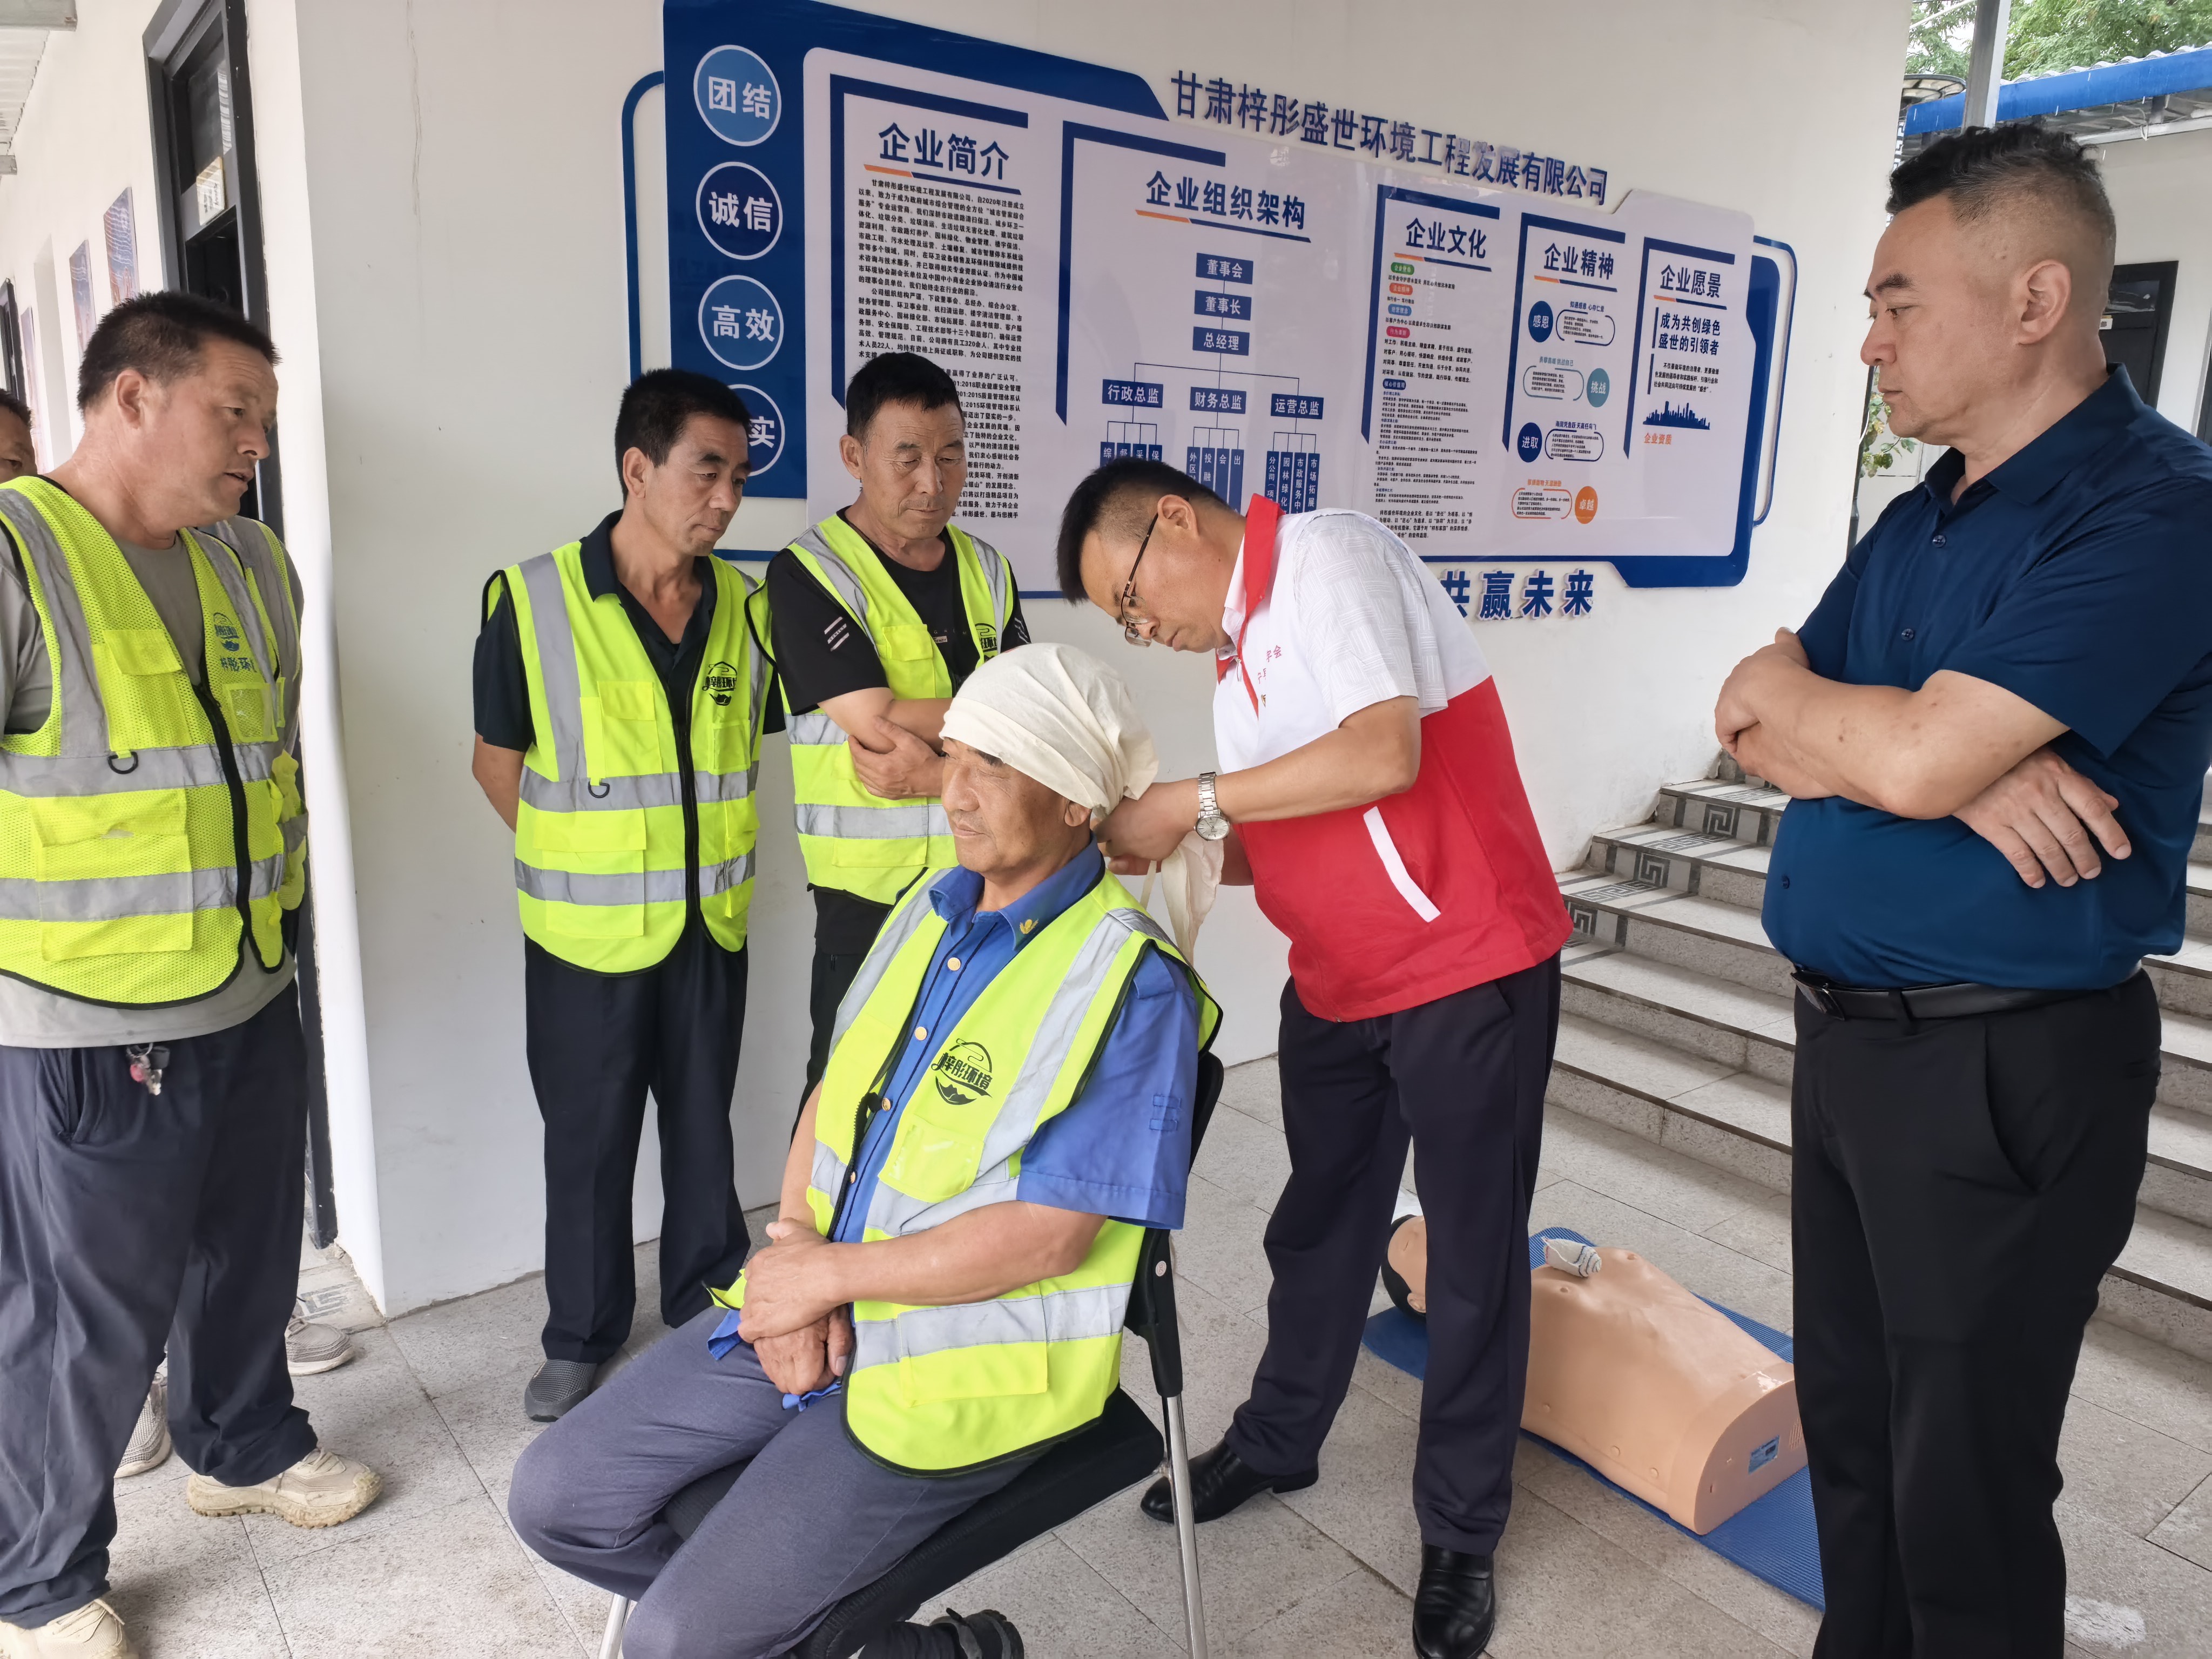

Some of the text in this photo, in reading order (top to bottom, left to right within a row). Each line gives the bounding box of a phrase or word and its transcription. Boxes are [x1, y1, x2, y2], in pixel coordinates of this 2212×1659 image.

[709, 77, 772, 119] 团结
[1171, 70, 1608, 205] 甘肃梓彤盛世环境工程发展有限公司
[879, 122, 1009, 180] 企业简介
[1146, 171, 1305, 230] 企业组织架构
[710, 192, 772, 232] 诚信
[1406, 218, 1487, 258] 企业文化
[1207, 259, 1243, 279] 董事会
[1543, 243, 1615, 281] 企业精神
[1660, 264, 1721, 298] 企业愿景
[1205, 296, 1241, 315] 董事长
[712, 305, 775, 342] 高效
[1533, 315, 1549, 328] 感恩
[1661, 313, 1721, 336] 成为共创绿色
[1204, 333, 1239, 350] 总经理
[1658, 333, 1719, 355] 盛世的引领者
[1108, 384, 1158, 403] 行政总监
[1590, 381, 1607, 394] 挑战
[1194, 392, 1242, 410] 财务总监
[1274, 398, 1319, 415] 运营总监
[1522, 436, 1539, 449] 进取
[1643, 433, 1672, 445] 企业资质
[1103, 448, 1112, 458] 综
[1151, 450, 1159, 461] 保
[1204, 454, 1212, 482] 投融
[1294, 458, 1303, 513] 市政服务中
[1579, 498, 1594, 511] 卓越
[1440, 569, 1593, 618] 共赢未来
[935, 1052, 993, 1090] 梓彤环境
